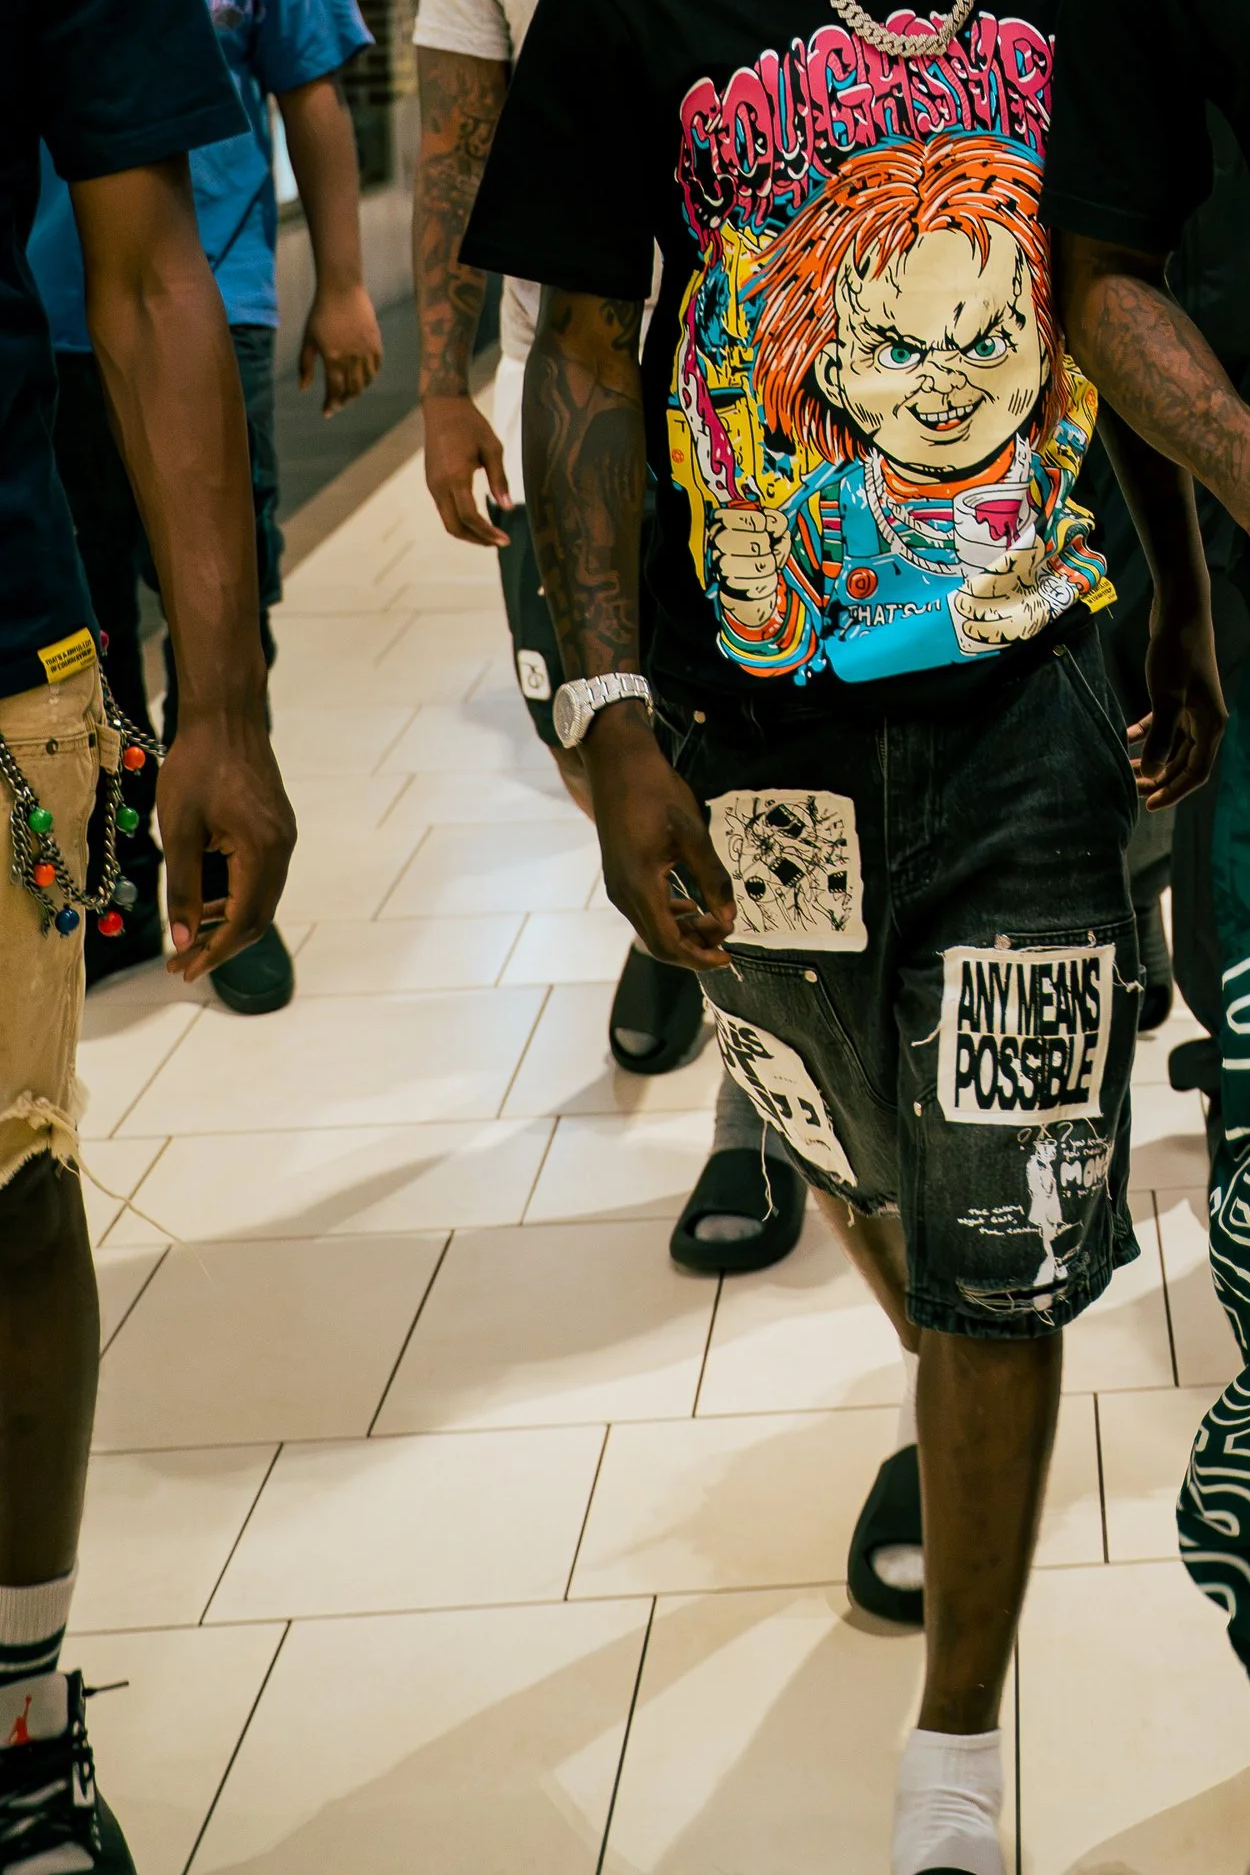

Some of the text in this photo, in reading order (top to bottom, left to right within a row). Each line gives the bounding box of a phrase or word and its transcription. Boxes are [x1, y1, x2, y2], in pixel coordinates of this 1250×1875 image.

[957, 956, 1101, 1037] ANY MEANS
[954, 1032, 1099, 1111] POSSIBLE
